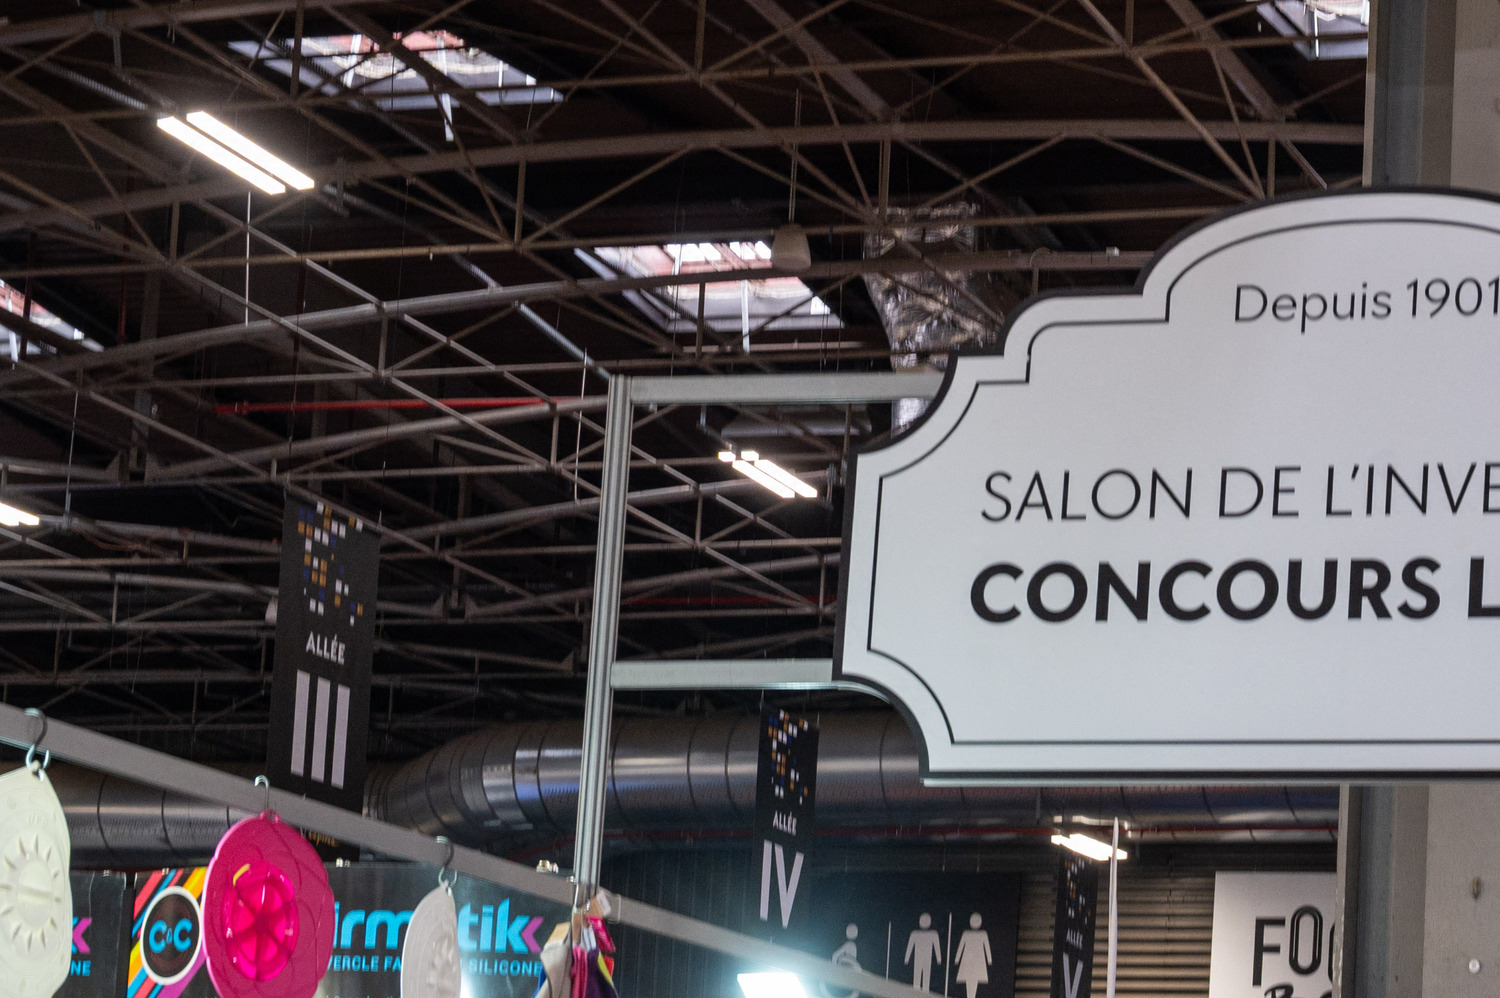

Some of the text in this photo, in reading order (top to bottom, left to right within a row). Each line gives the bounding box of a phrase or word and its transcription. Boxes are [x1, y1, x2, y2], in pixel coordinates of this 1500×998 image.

[1233, 281, 1392, 334] Depuis
[981, 466, 1193, 522] SALON
[1218, 465, 1300, 518] DE
[970, 558, 1440, 623] CONCOURS
[306, 631, 346, 666] ALLÉE
[290, 669, 351, 790] III
[772, 810, 797, 836] ALLÉE
[759, 839, 805, 929] IV
[1066, 929, 1084, 950] ALLÉE
[1252, 905, 1336, 988] FO
[468, 958, 541, 978] SILICONE
